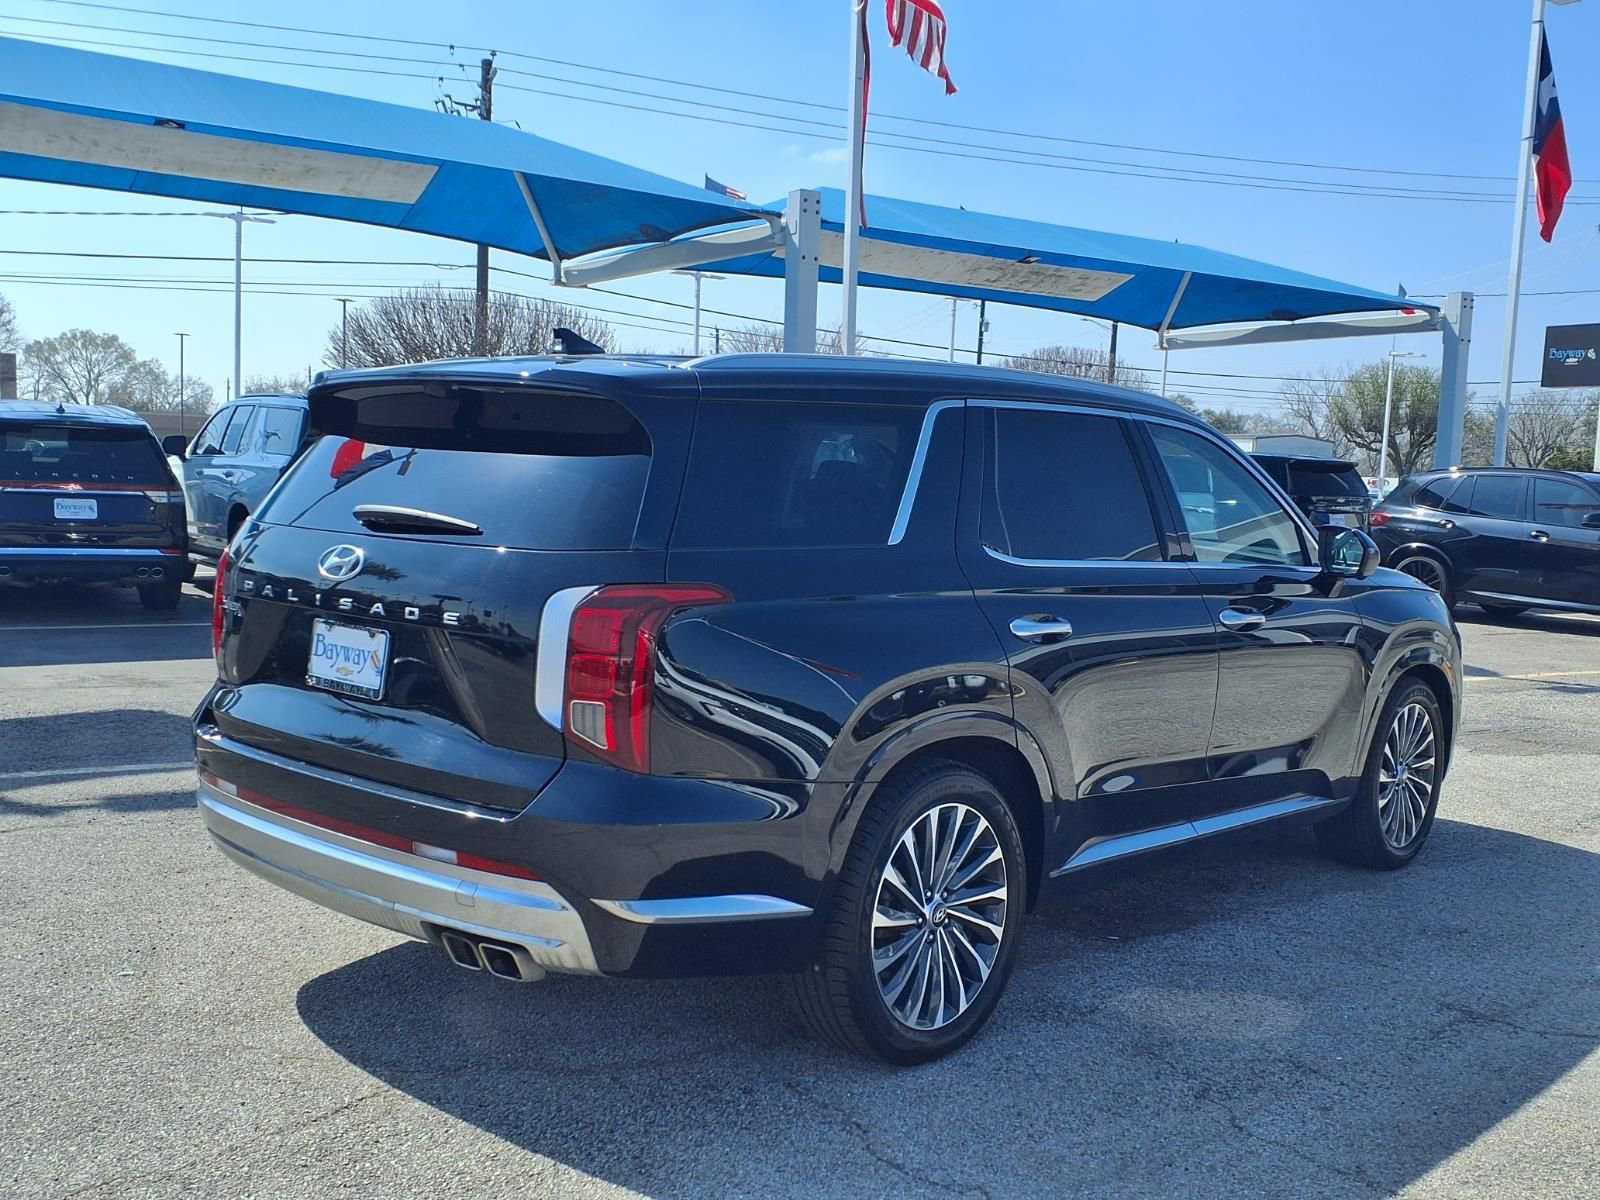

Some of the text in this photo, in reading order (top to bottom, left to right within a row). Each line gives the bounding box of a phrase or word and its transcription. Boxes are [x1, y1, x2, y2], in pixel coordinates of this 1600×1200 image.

[1549, 347, 1587, 362] Bayway
[243, 580, 461, 626] PALISADE
[313, 633, 371, 673] Bayway
